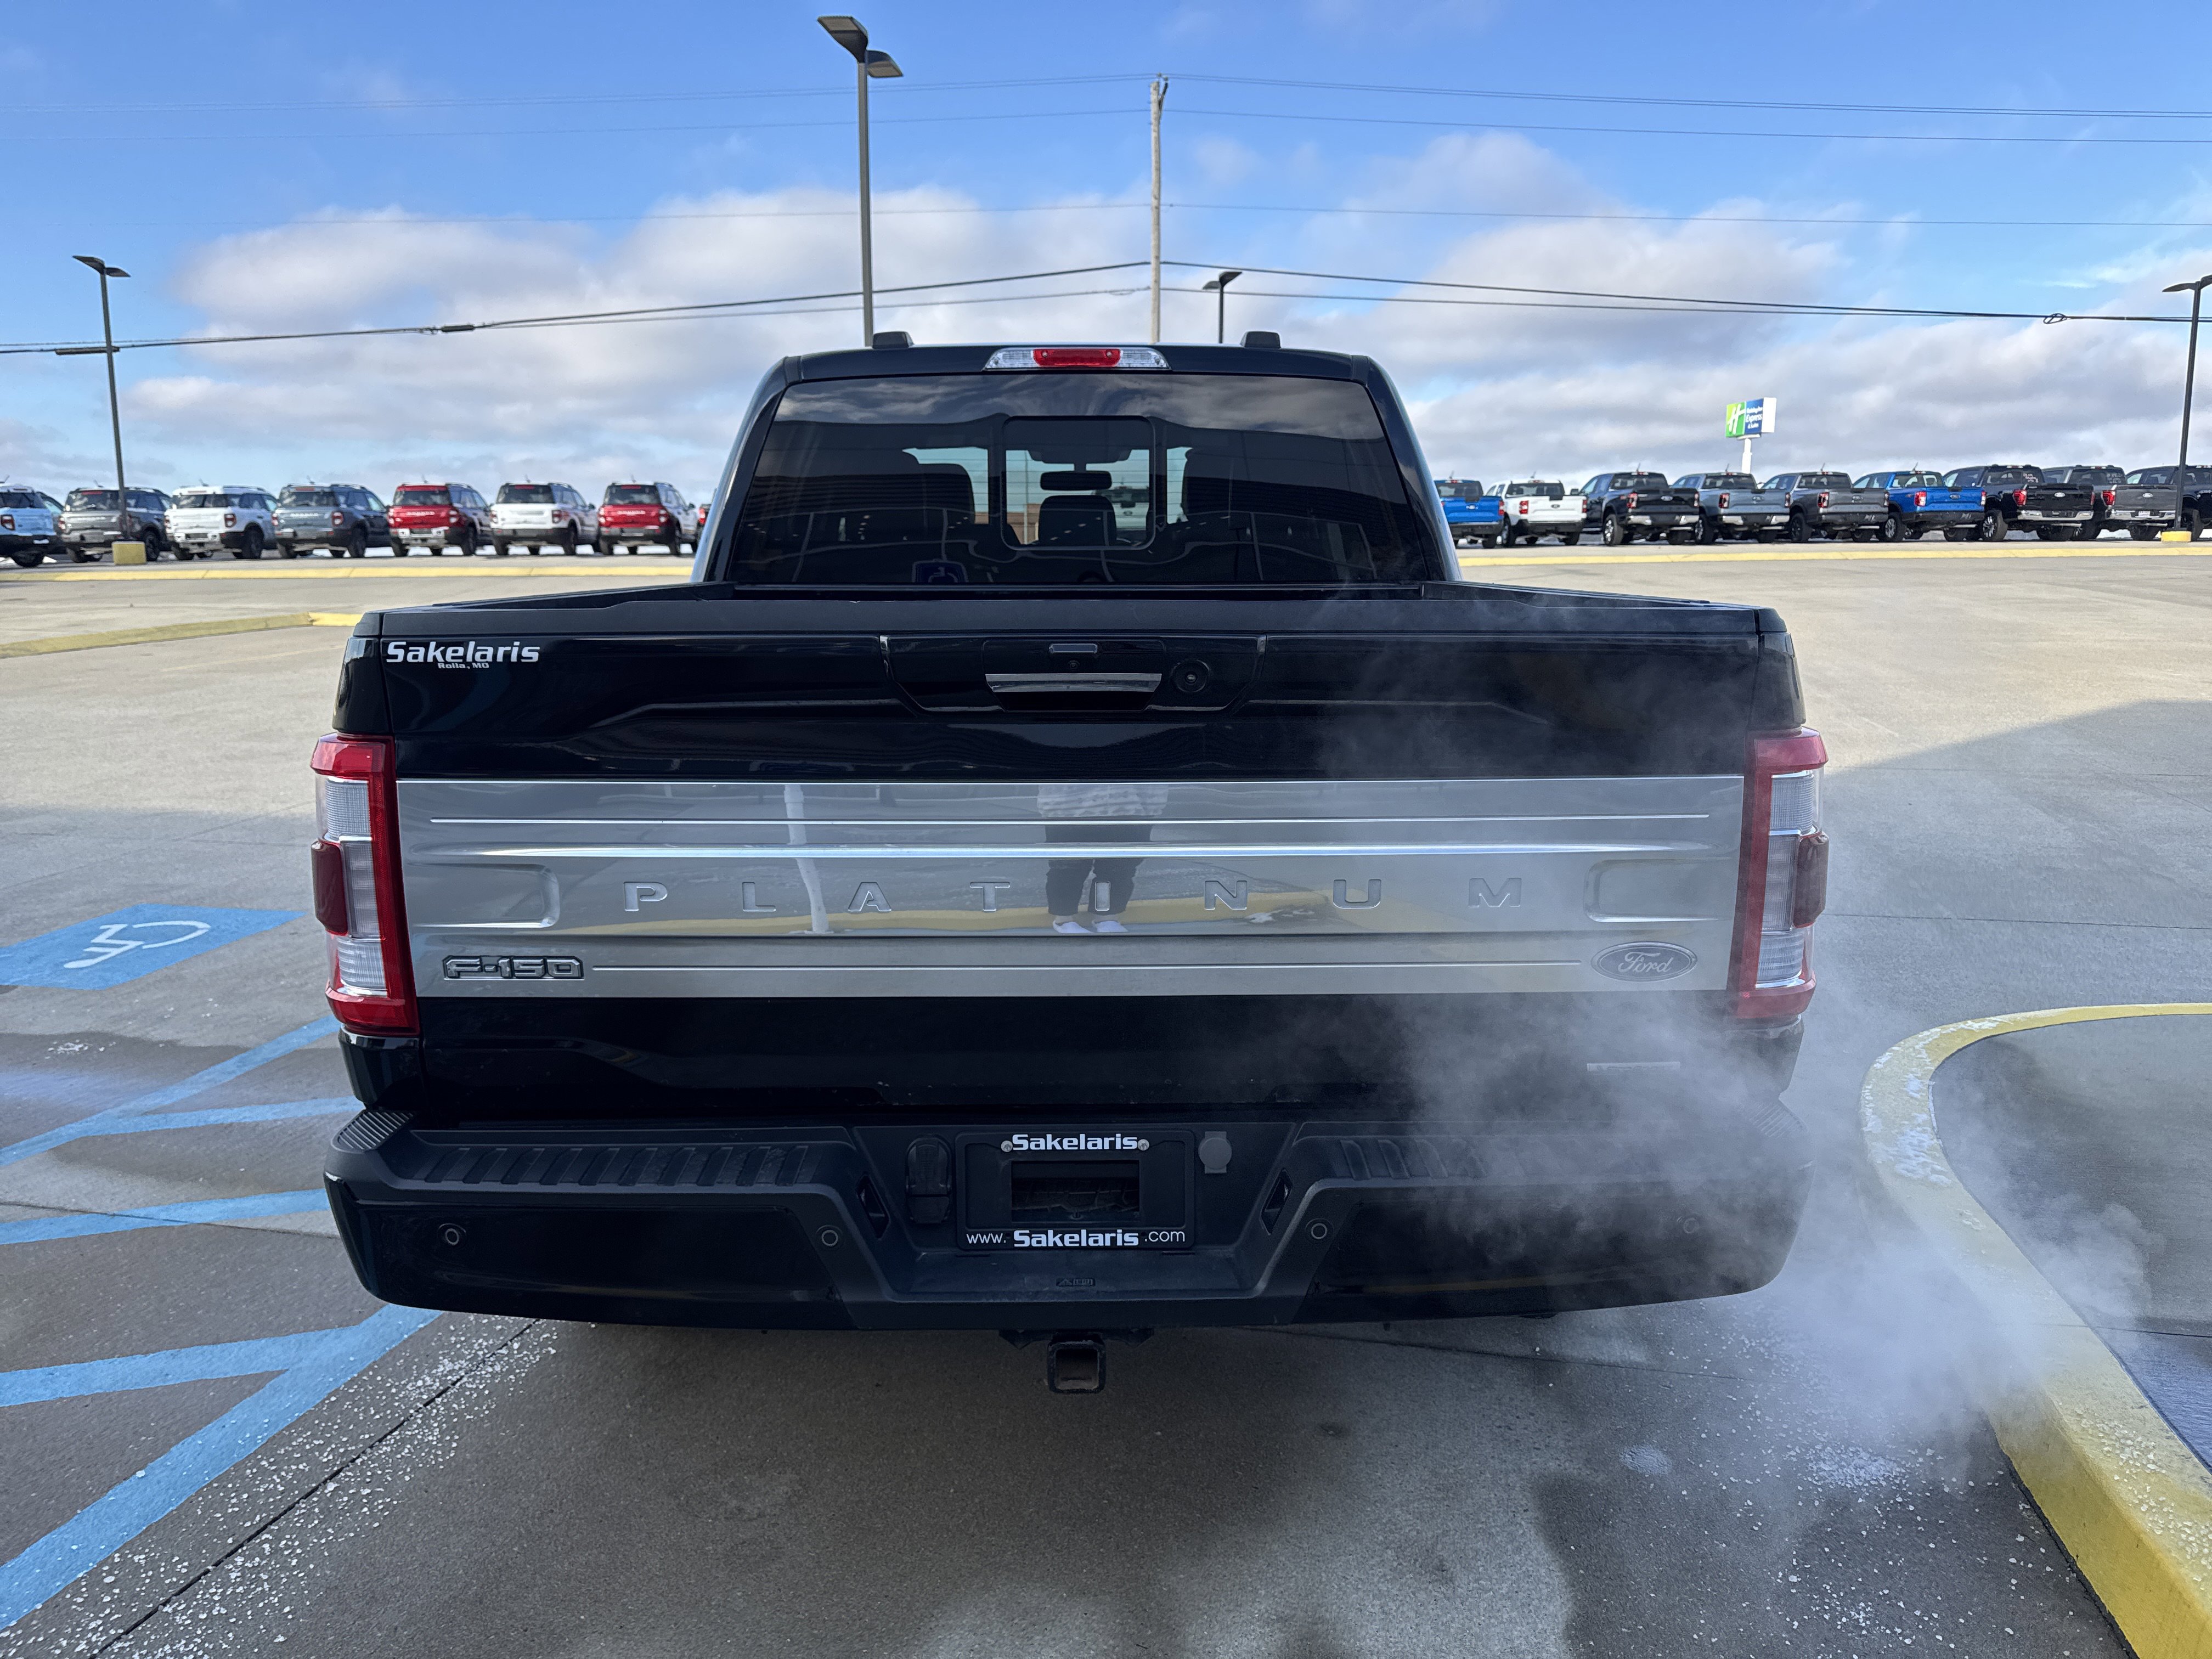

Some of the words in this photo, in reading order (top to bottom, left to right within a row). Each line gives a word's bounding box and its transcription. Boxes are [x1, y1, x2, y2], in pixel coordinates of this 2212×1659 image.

[386, 641, 540, 662] Sakelaris
[623, 877, 1522, 913] PLATINUM
[443, 955, 584, 980] F-150
[1618, 951, 1674, 973] Ford
[1012, 1133, 1138, 1150] Sakelaris
[966, 1233, 1006, 1244] www.
[1013, 1229, 1139, 1246] Sakelaris
[1144, 1231, 1185, 1242] .com
